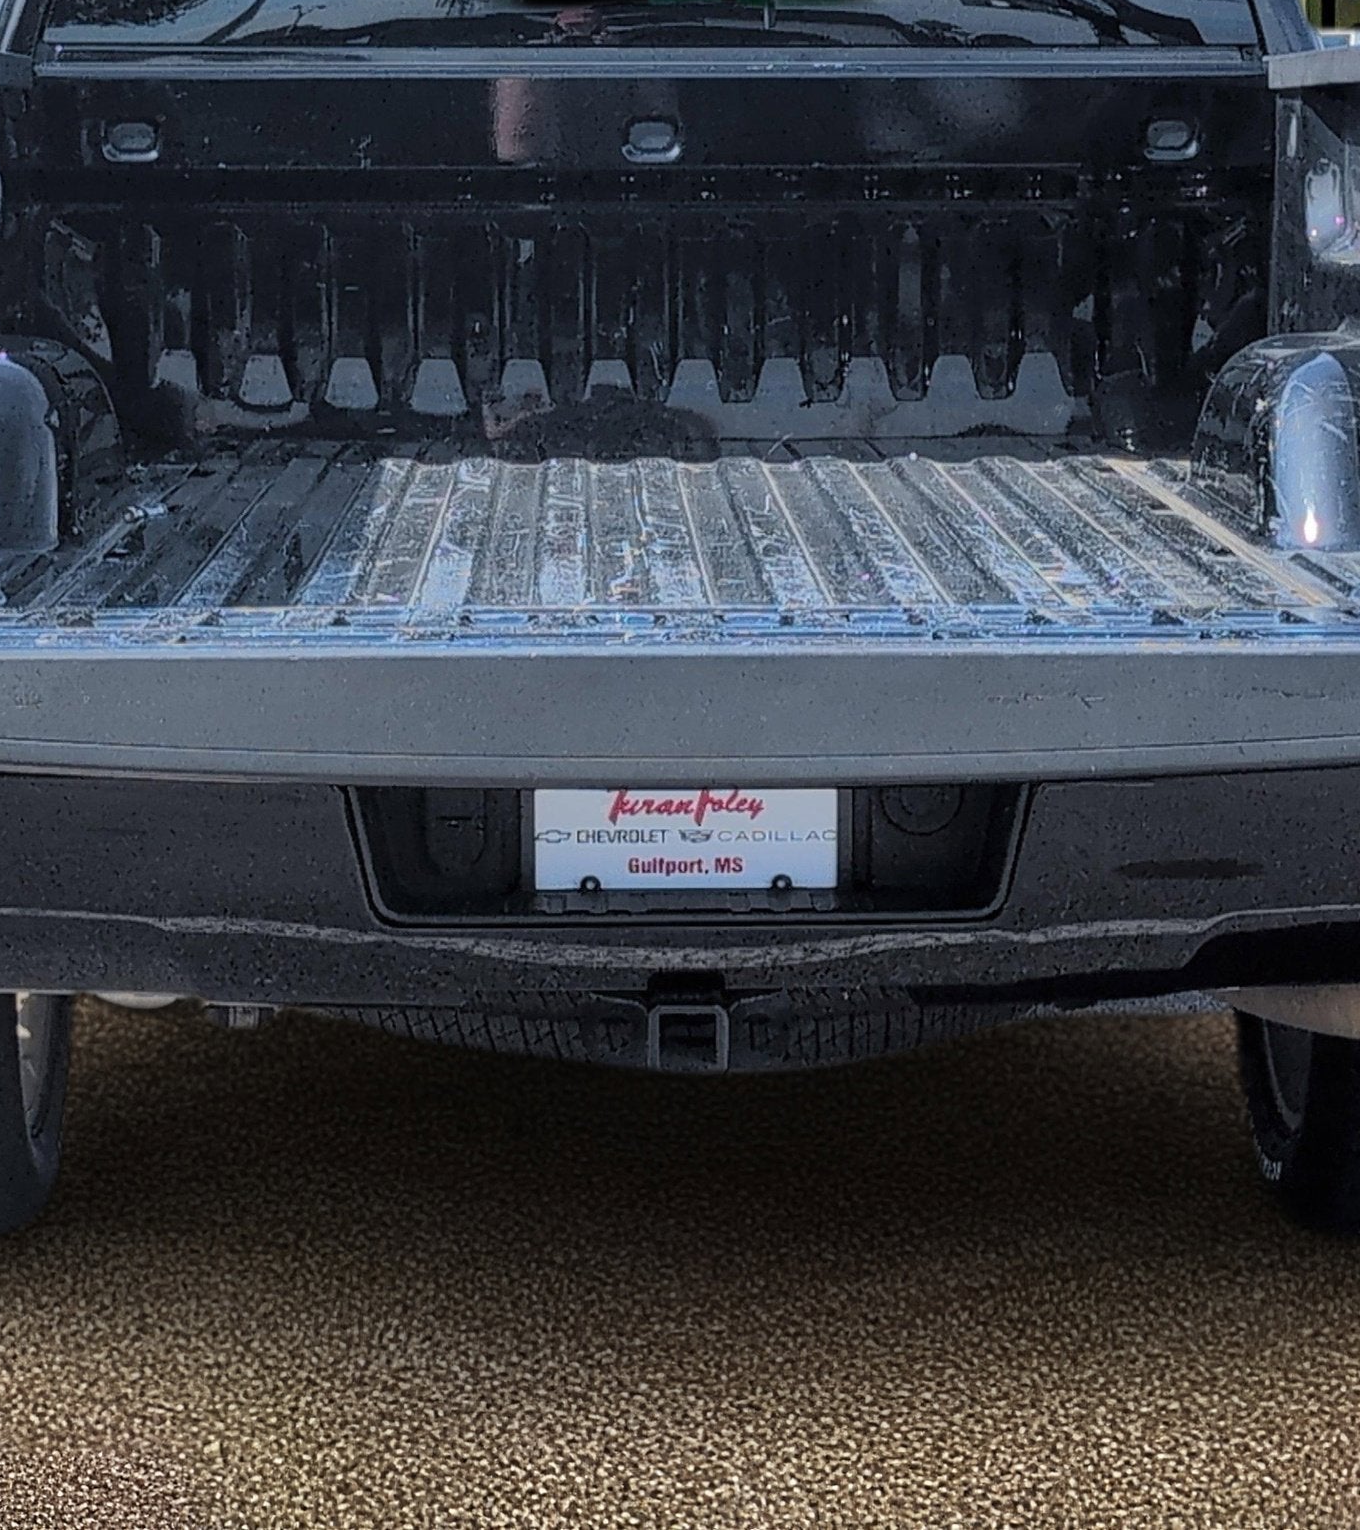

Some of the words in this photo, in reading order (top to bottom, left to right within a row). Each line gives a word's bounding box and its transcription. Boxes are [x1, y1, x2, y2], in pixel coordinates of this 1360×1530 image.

[576, 829, 668, 844] CHEVROLET
[717, 830, 837, 842] CADILLAC
[627, 856, 709, 877] Gulfport,
[714, 856, 744, 874] MS
